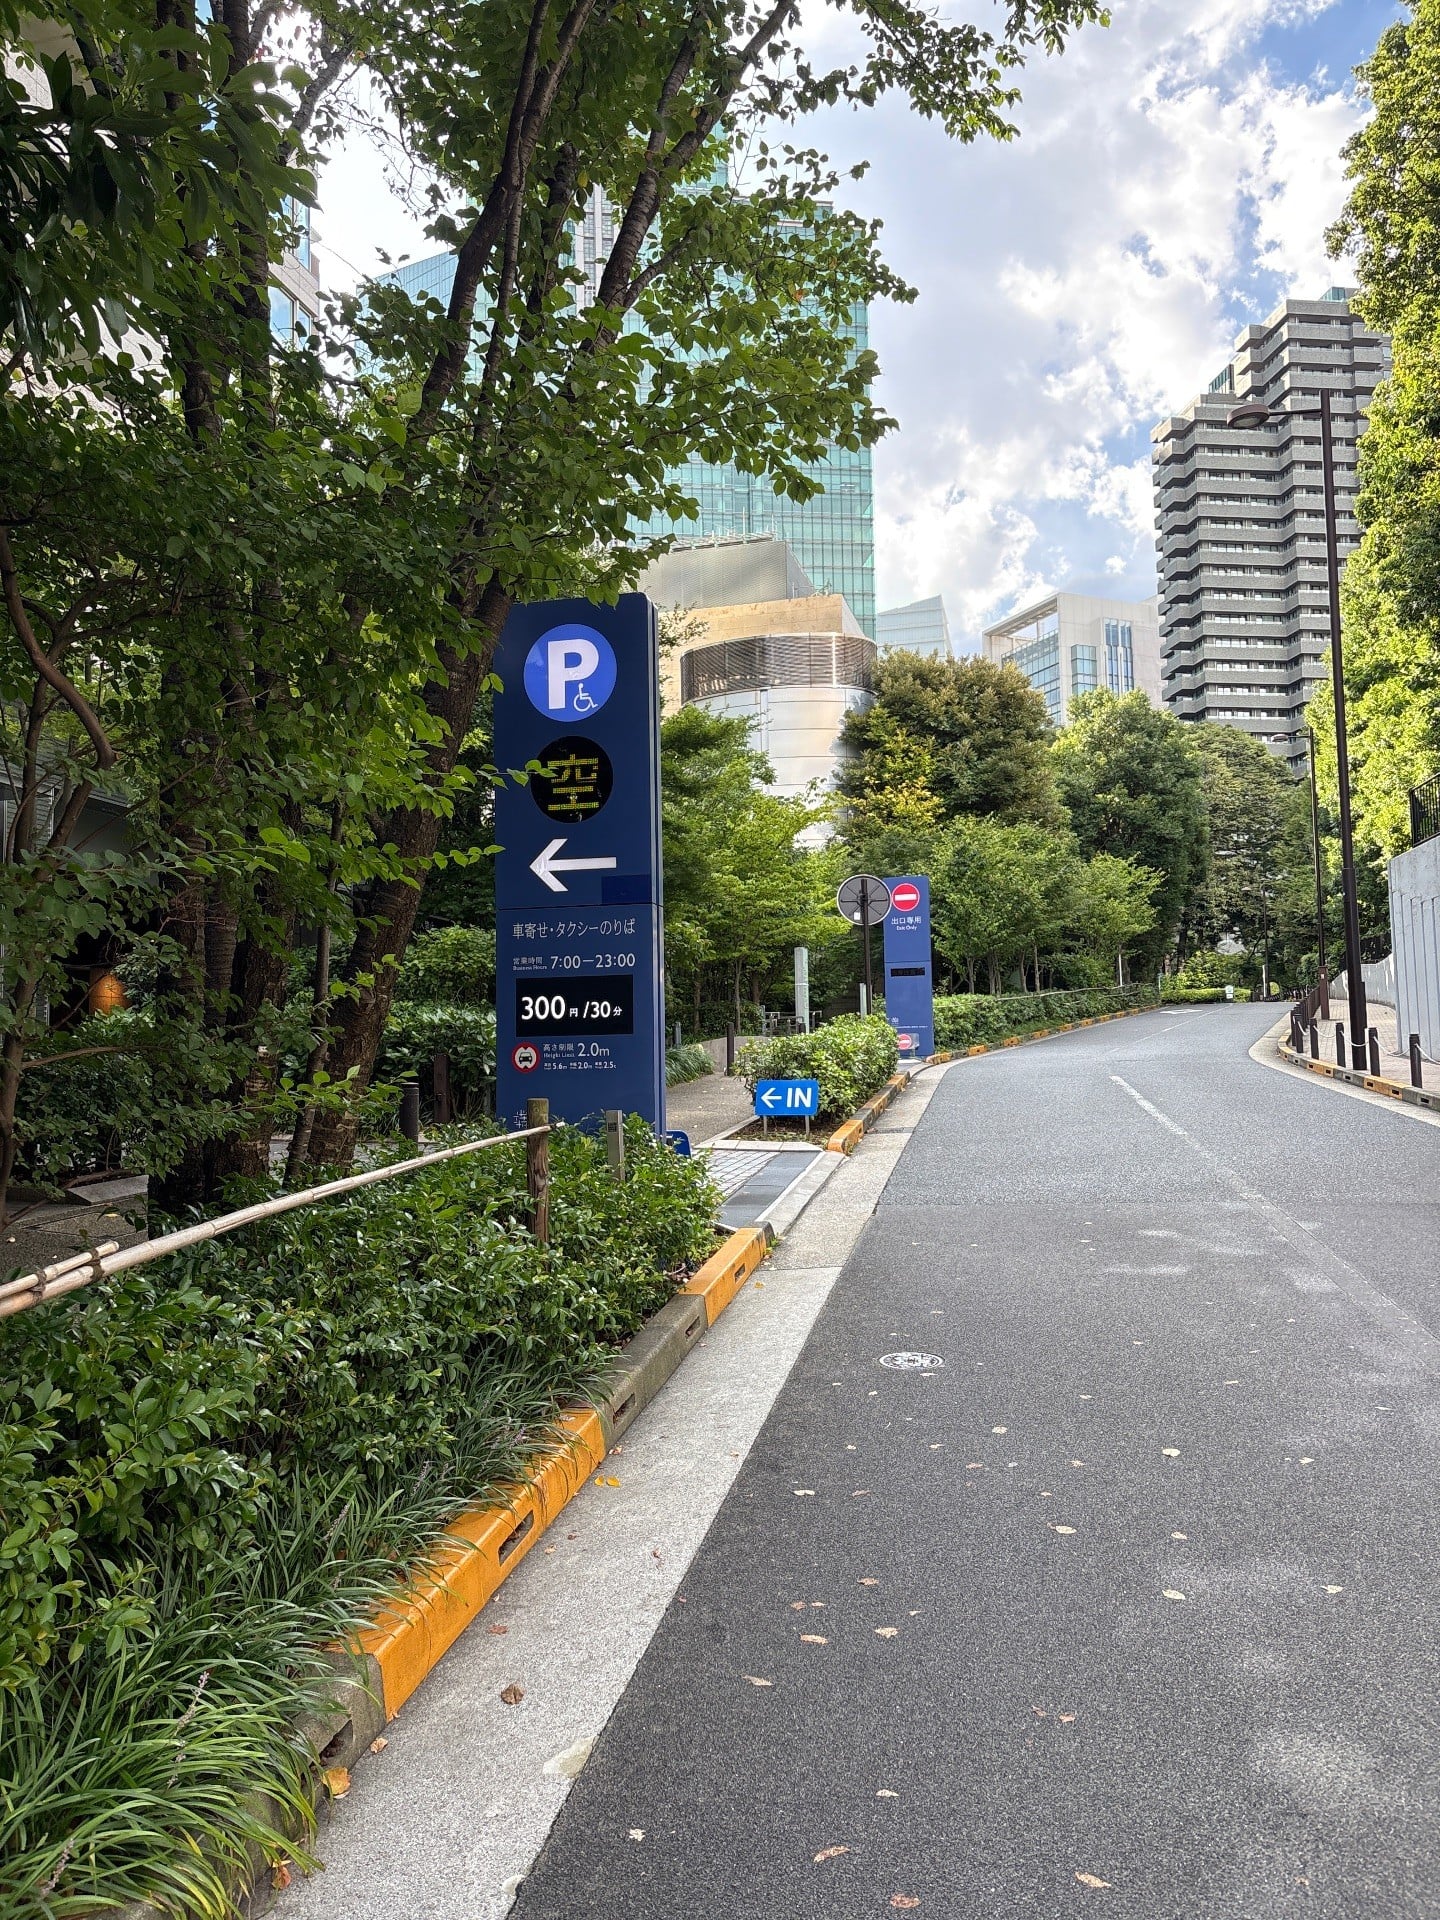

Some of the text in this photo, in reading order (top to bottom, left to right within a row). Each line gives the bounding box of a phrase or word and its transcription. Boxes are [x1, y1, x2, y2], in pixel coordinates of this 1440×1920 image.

[547, 638, 599, 710] P
[547, 753, 599, 811] 空
[512, 918, 636, 940] 車寄せ・タクシーのりば
[891, 916, 922, 925] 出口専用
[577, 1042, 610, 1057] 2.0m
[786, 1087, 813, 1108] IN
